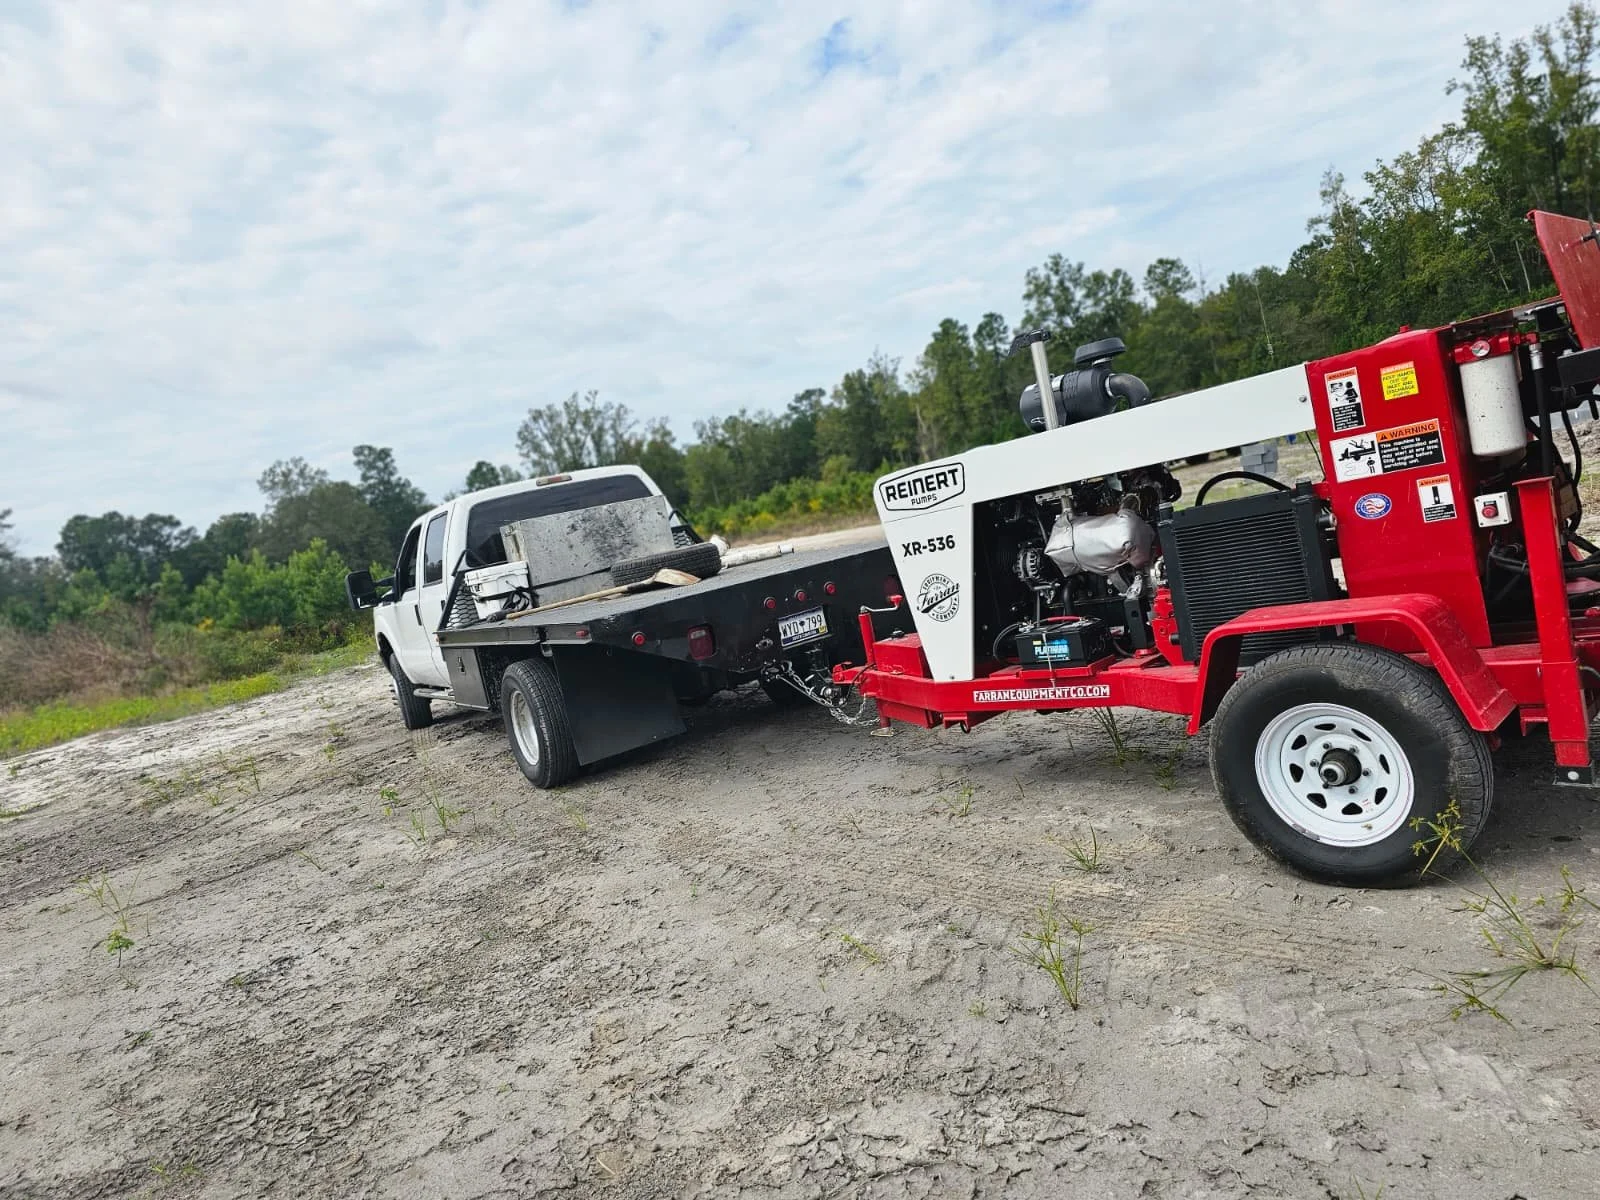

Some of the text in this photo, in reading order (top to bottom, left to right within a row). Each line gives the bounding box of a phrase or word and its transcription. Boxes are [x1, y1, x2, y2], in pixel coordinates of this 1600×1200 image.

[1390, 424, 1435, 438] WARNING
[885, 468, 959, 502] REINERT
[911, 493, 938, 506] PUMPS
[902, 534, 956, 557] XR-536
[806, 614, 822, 629] 799
